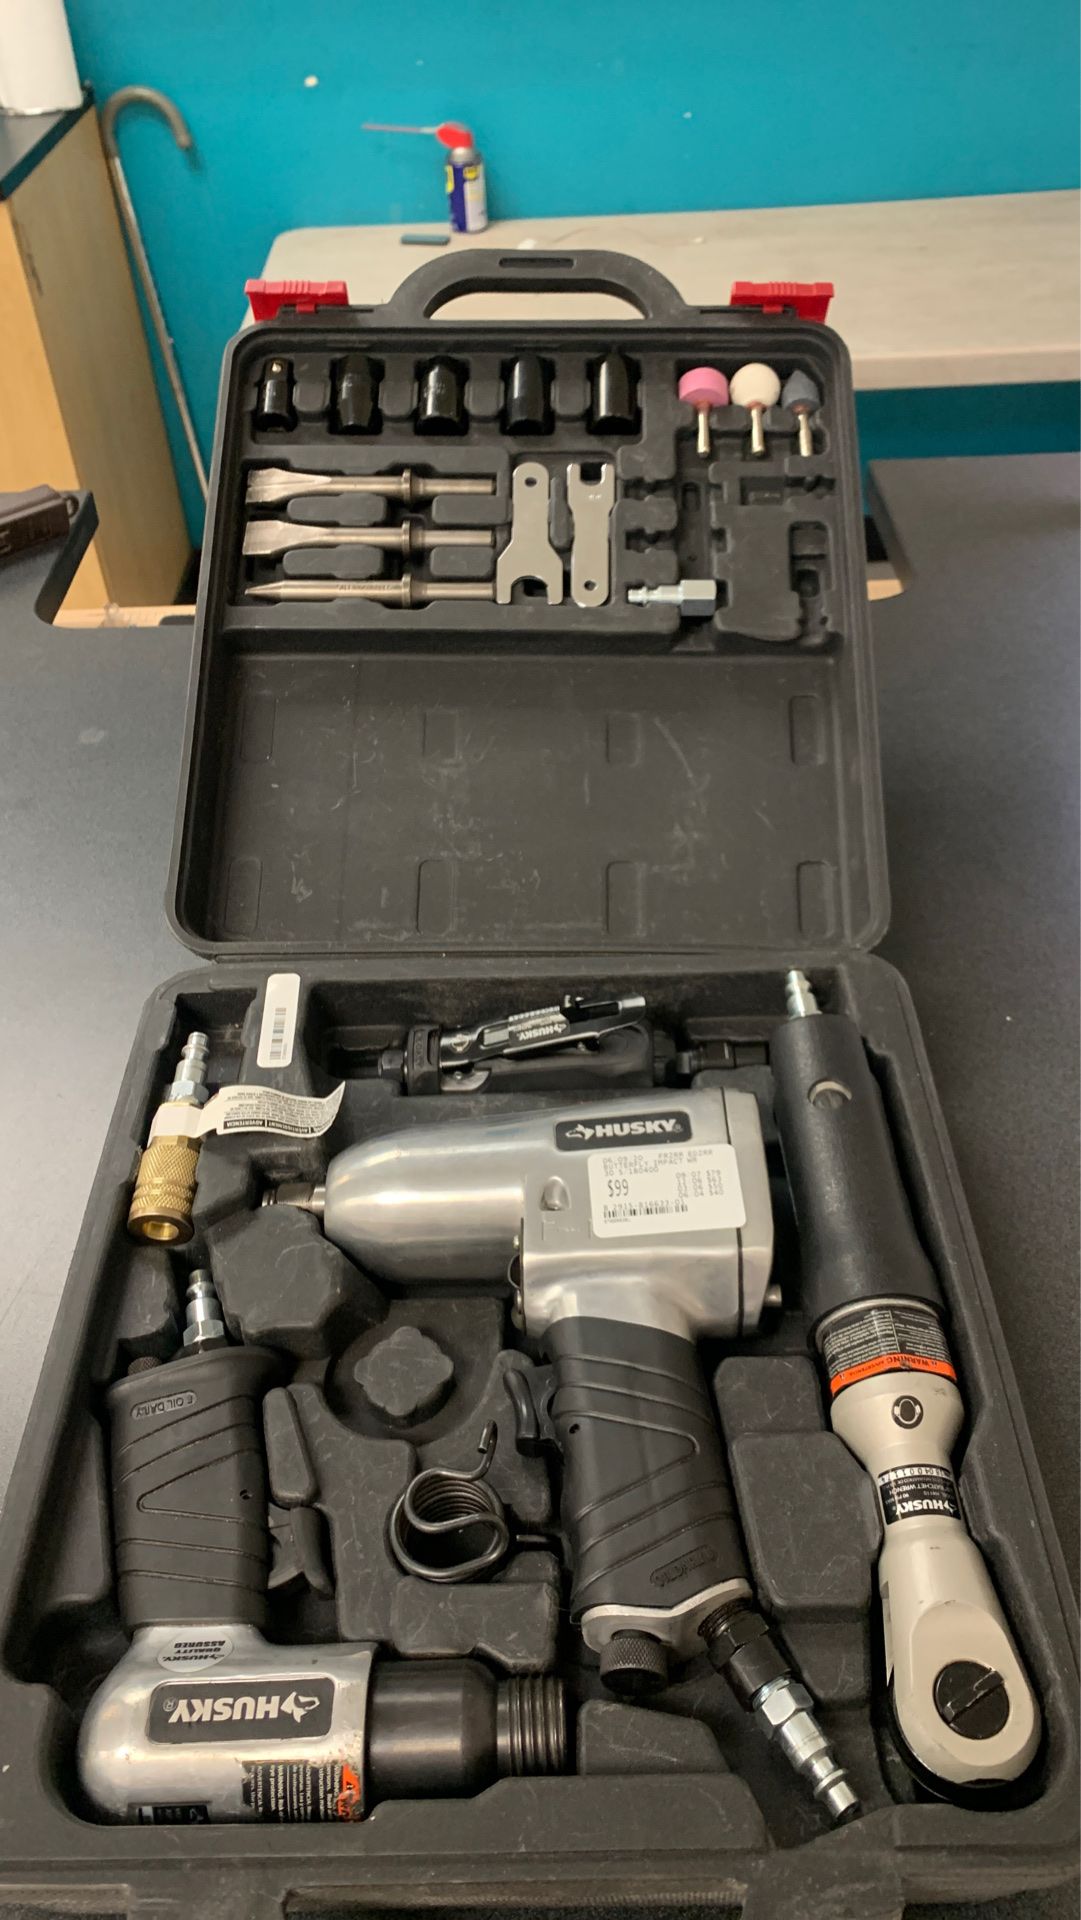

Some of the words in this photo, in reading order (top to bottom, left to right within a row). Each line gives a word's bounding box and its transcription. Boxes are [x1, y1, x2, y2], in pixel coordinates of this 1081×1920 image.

[519, 1025, 554, 1041] HUSKY
[595, 1119, 677, 1138] HUSKY
[653, 1158, 685, 1168] IMPACT
[608, 1179, 630, 1197] $99
[896, 1499, 944, 1515] HUSKY
[174, 1640, 226, 1649] ASSURED
[176, 1647, 221, 1655] QUALITY
[163, 1654, 208, 1662] HUSKY
[168, 1695, 280, 1723] HUSKY
